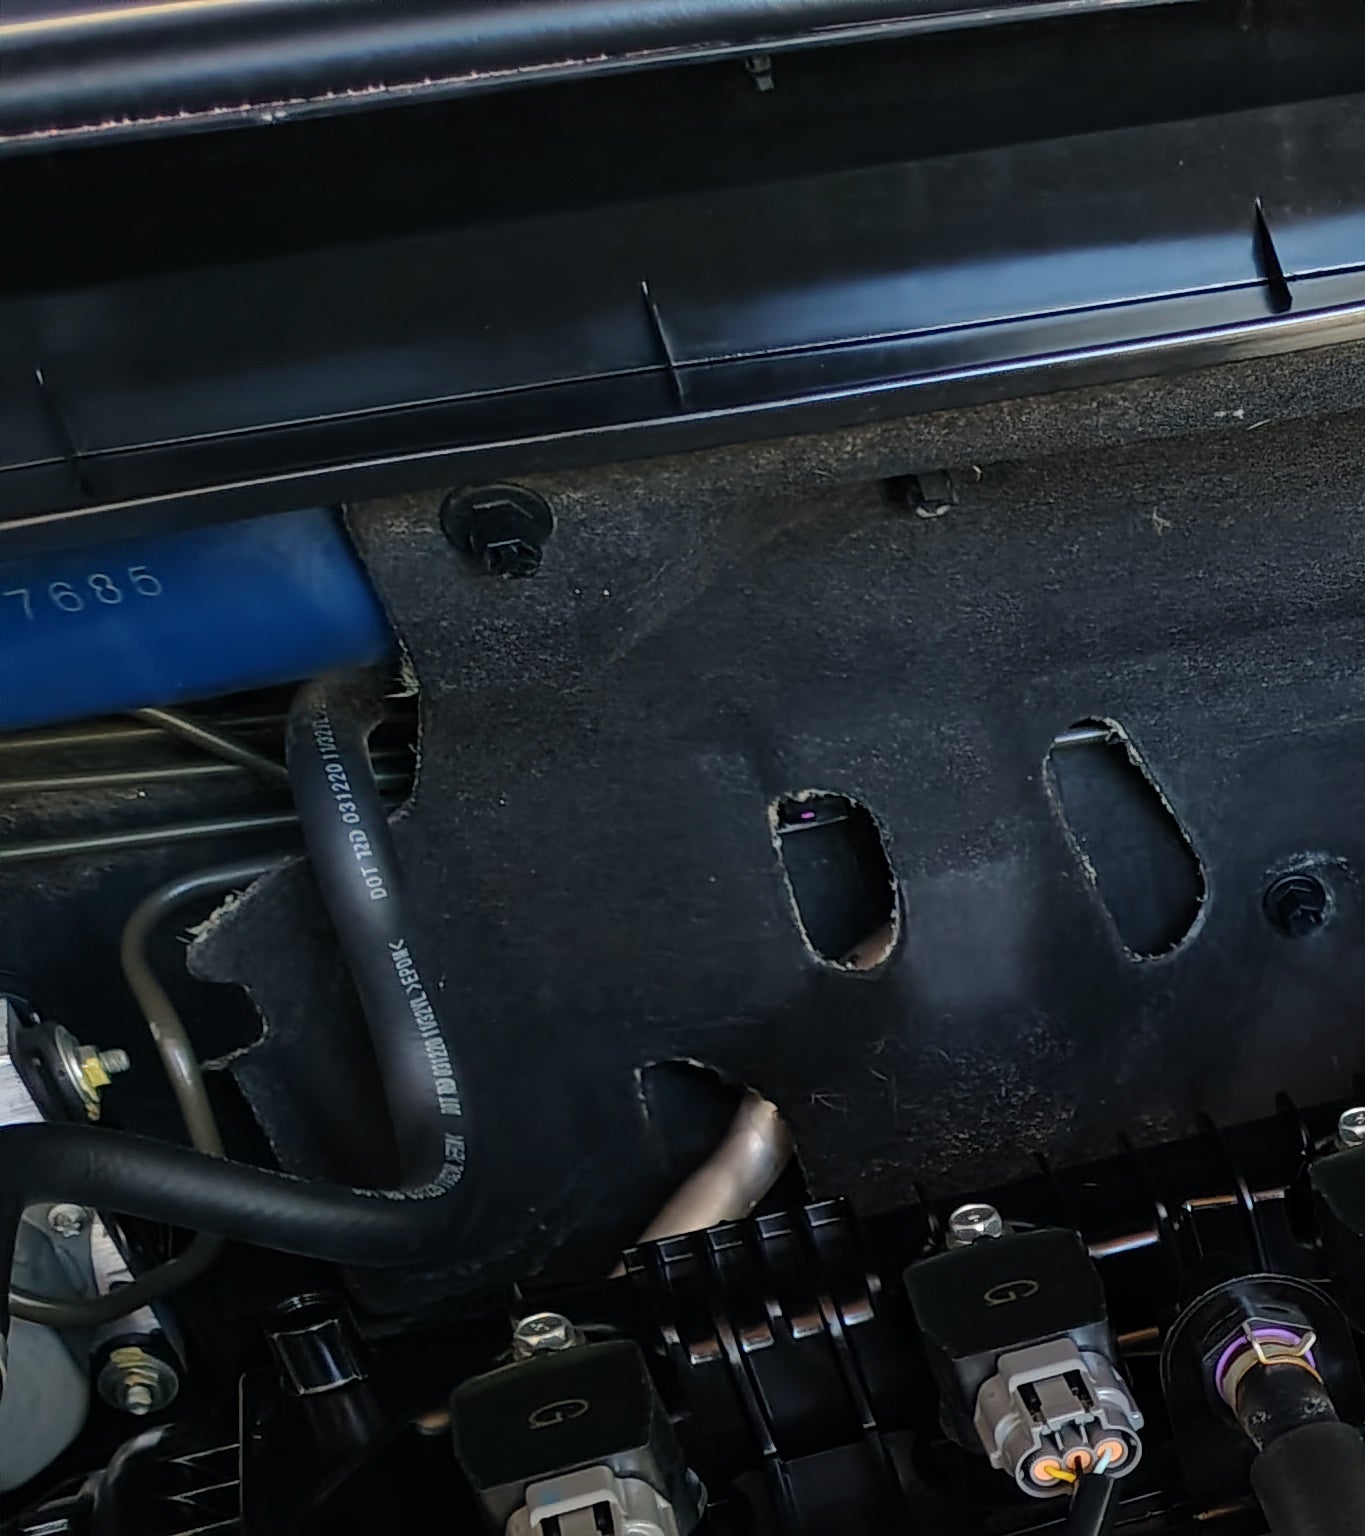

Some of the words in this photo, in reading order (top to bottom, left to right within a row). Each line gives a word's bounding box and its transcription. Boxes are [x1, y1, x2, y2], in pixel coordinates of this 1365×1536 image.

[2, 564, 164, 622] 7685
[324, 762, 361, 824] 031220
[361, 866, 388, 900] DOT
